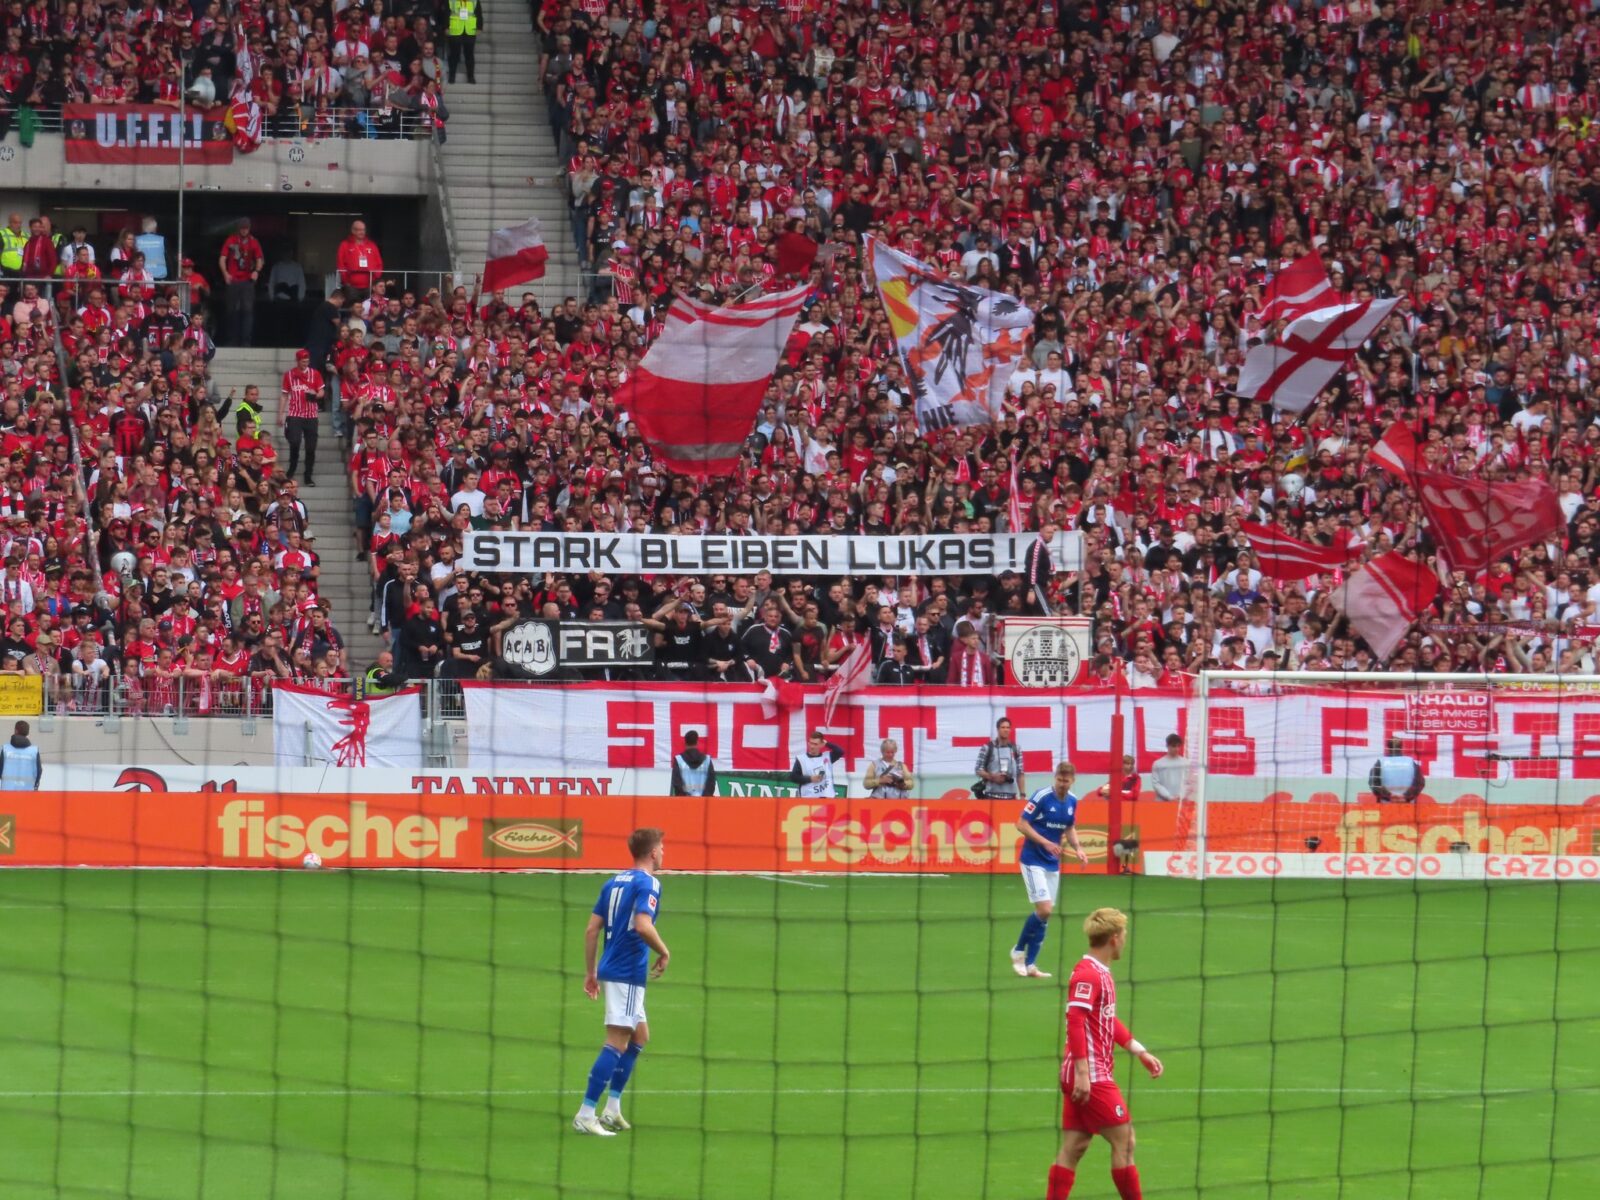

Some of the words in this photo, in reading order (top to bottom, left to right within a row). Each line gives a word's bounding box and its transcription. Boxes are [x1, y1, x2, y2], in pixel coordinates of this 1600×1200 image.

[473, 535, 621, 569] STARK
[641, 537, 828, 570] BLEIBEN
[848, 537, 994, 570] LUKAS
[505, 638, 545, 655] ACAB
[1410, 694, 1488, 706] KHALID
[1411, 706, 1440, 718] FÜR
[1443, 708, 1488, 718] IMMER
[1422, 719, 1444, 728] BEI
[1447, 719, 1478, 729] UNS
[218, 799, 468, 859] fischer
[503, 830, 556, 843] fischer
[781, 804, 1026, 866] fischer
[1335, 810, 1577, 854] fischer
[1167, 854, 1282, 874] CAZOO
[1325, 855, 1441, 876] CAZOO
[1485, 855, 1599, 877] CAZOO
